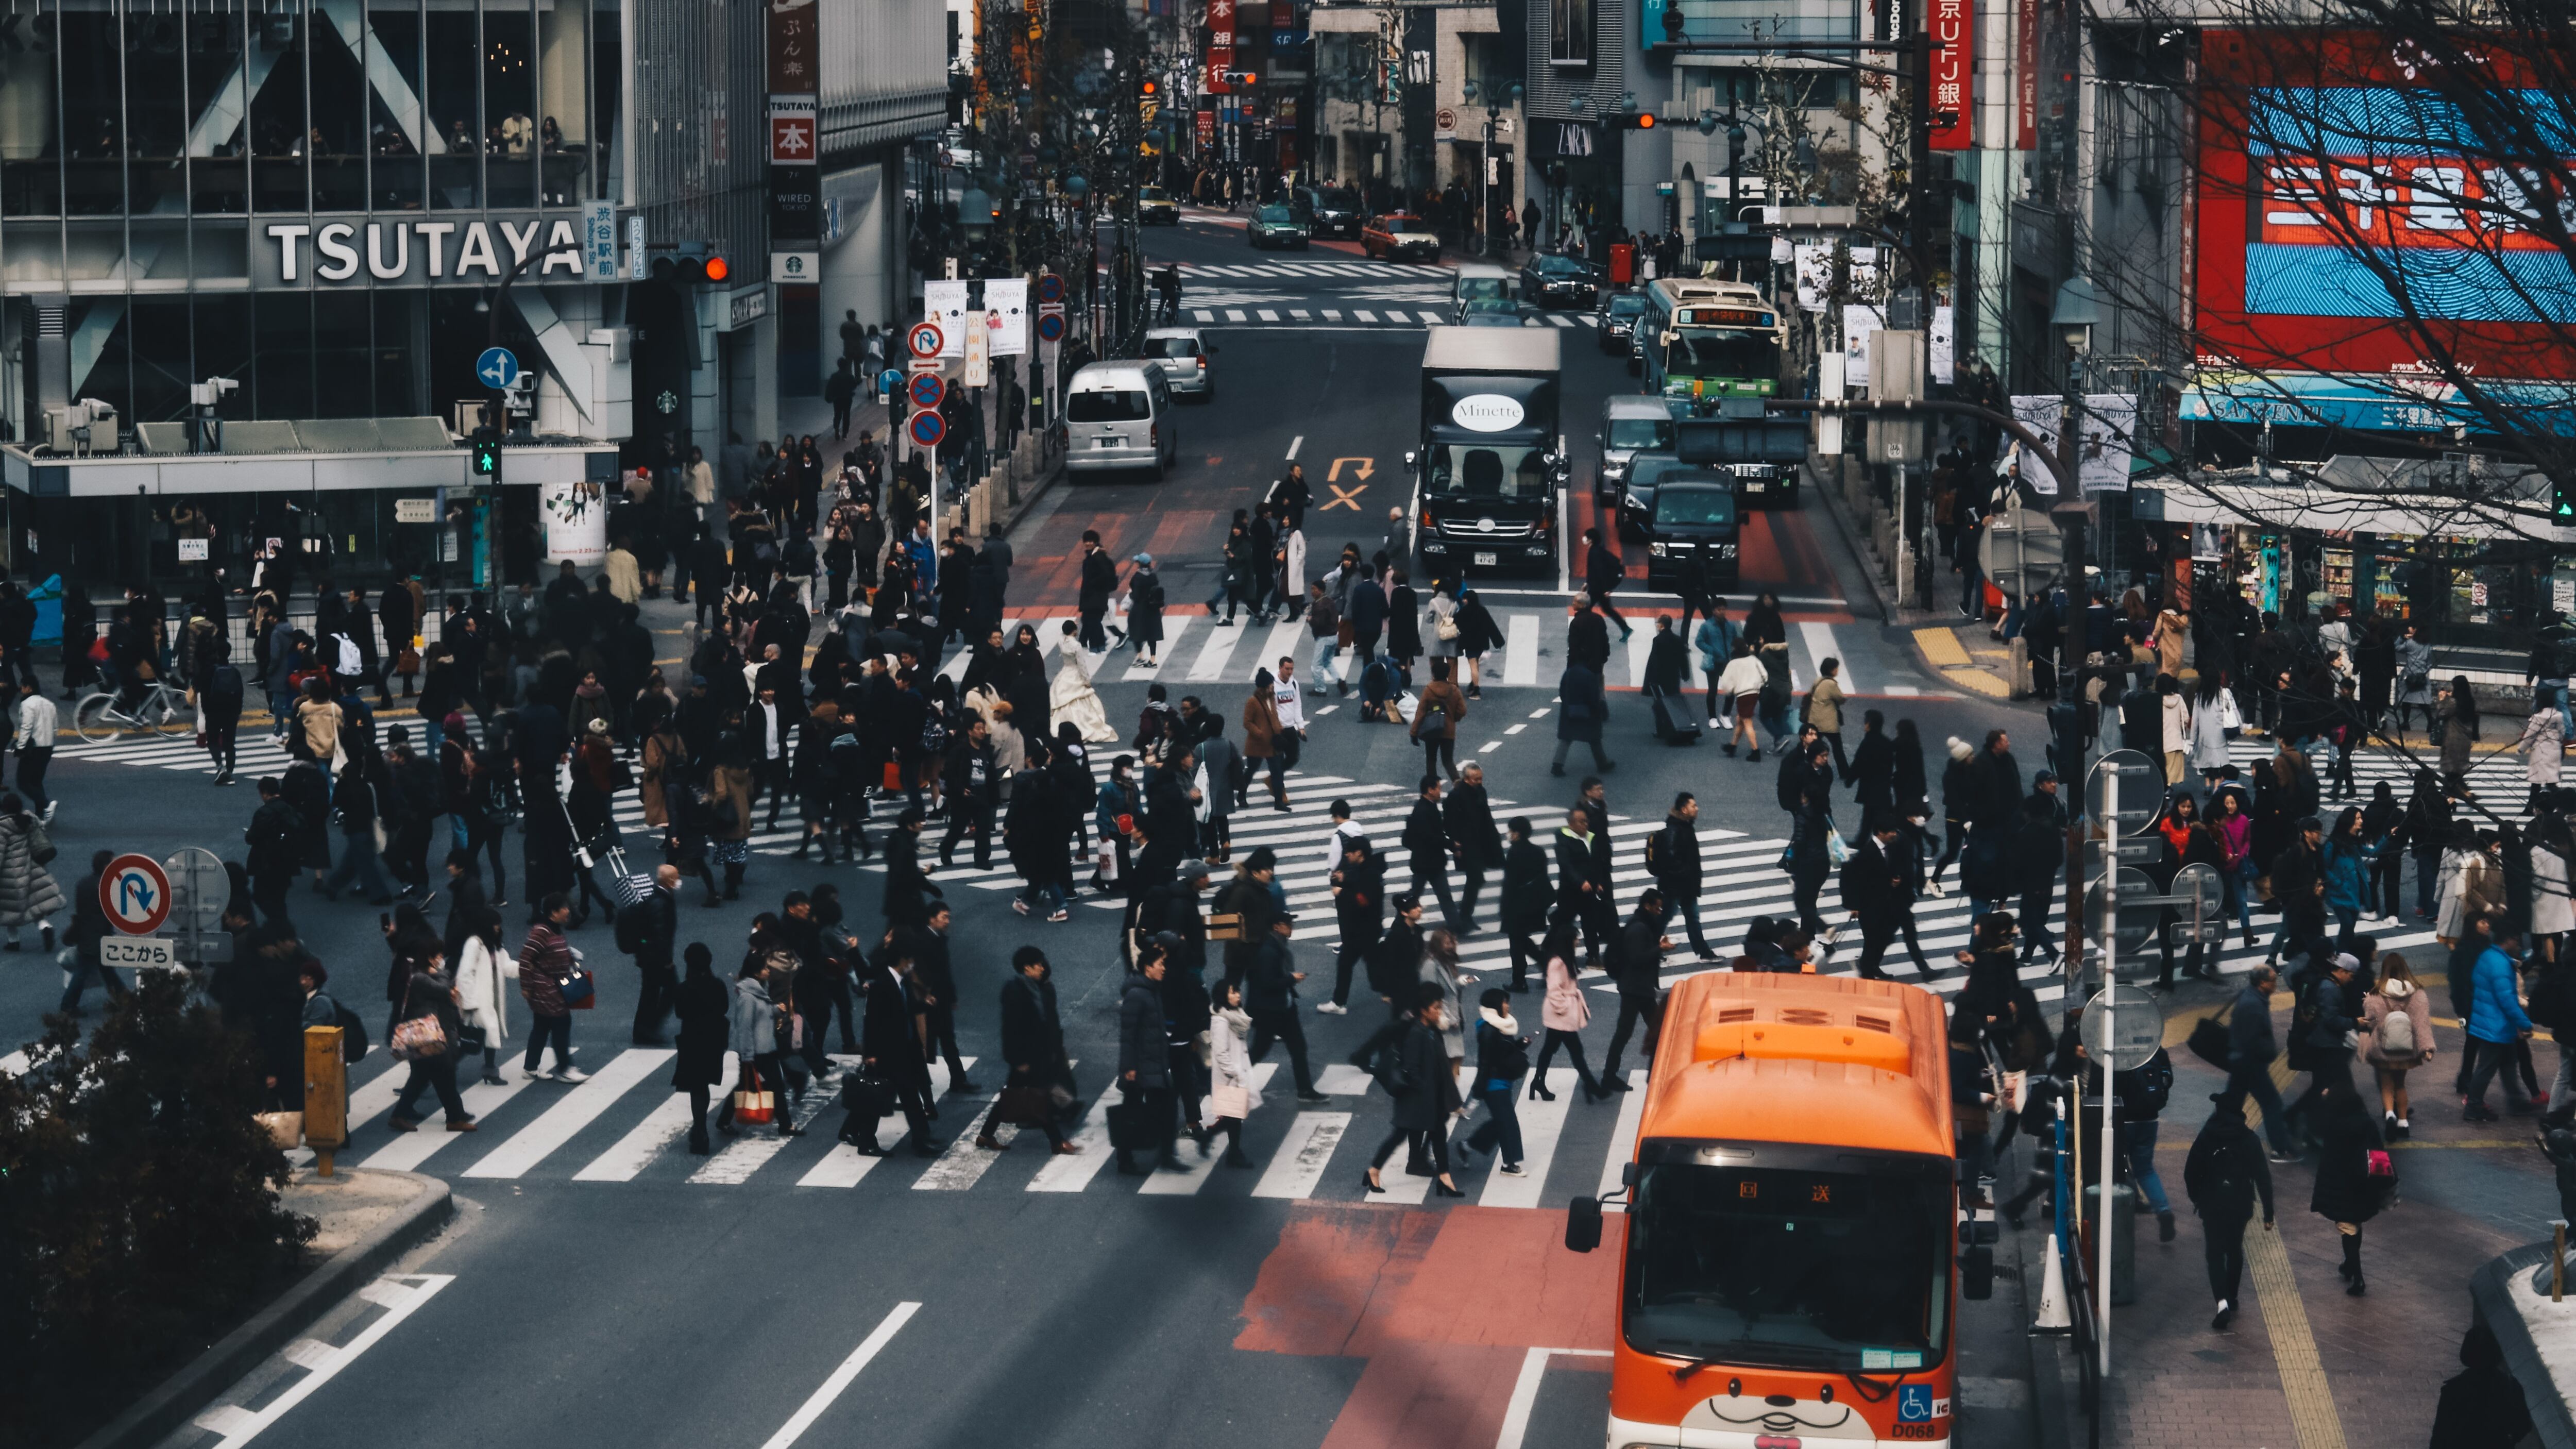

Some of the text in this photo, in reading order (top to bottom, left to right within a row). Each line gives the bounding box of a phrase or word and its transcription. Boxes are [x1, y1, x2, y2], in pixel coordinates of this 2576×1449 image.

[771, 103, 816, 111] TSUTAYA
[778, 124, 809, 155] 本
[1558, 124, 1592, 156] ZARA
[777, 194, 811, 203] WIRED
[268, 220, 584, 280] TSUTAYA
[597, 207, 613, 275] 渋谷駅前
[633, 221, 642, 276] スクランブル式
[969, 317, 979, 378] 公園通り
[1459, 405, 1520, 417] Minette
[106, 947, 168, 964] ここから
[1892, 1424, 1935, 1438] D068
